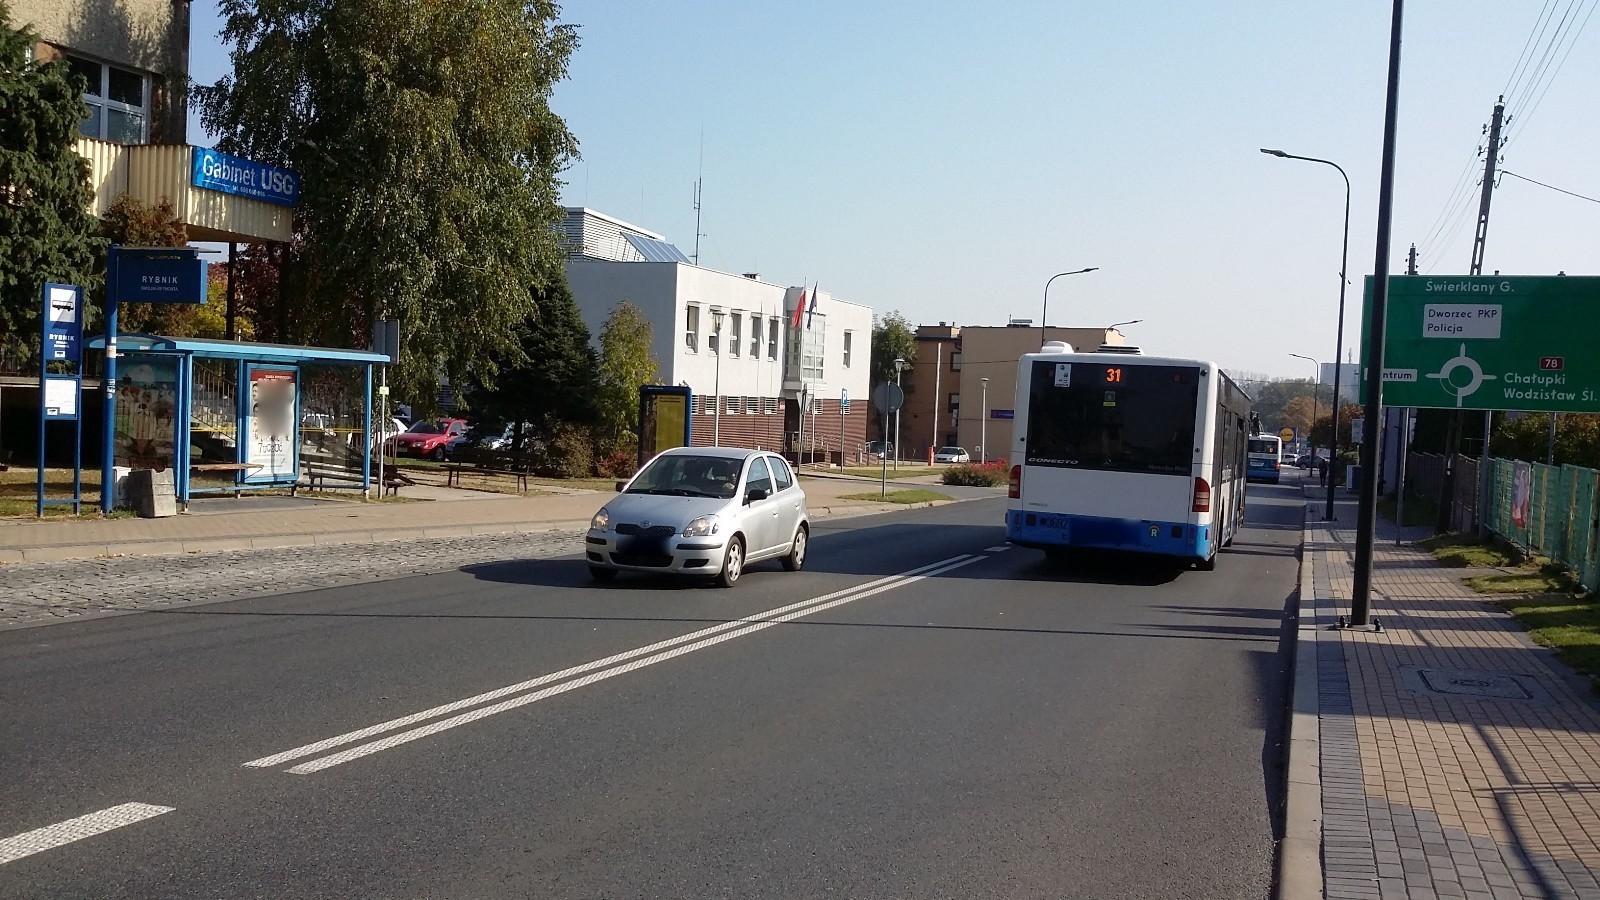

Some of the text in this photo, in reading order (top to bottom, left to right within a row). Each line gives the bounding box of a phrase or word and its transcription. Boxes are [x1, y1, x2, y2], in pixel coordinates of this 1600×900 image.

[203, 155, 255, 186] Gabinet
[261, 168, 293, 195] USG
[142, 275, 178, 284] RYBNIK
[1425, 278, 1515, 295] Świerklany G.
[1428, 309, 1498, 318] Dworzec PKP
[1427, 323, 1463, 334] Policja
[1544, 358, 1558, 368] 78
[1105, 368, 1121, 383] 31
[1382, 371, 1412, 380] ntrum
[1504, 372, 1566, 388] Chałupki
[1503, 387, 1576, 401] Wodzisław
[1028, 457, 1079, 465] CONECTO
[1151, 528, 1158, 537] R
